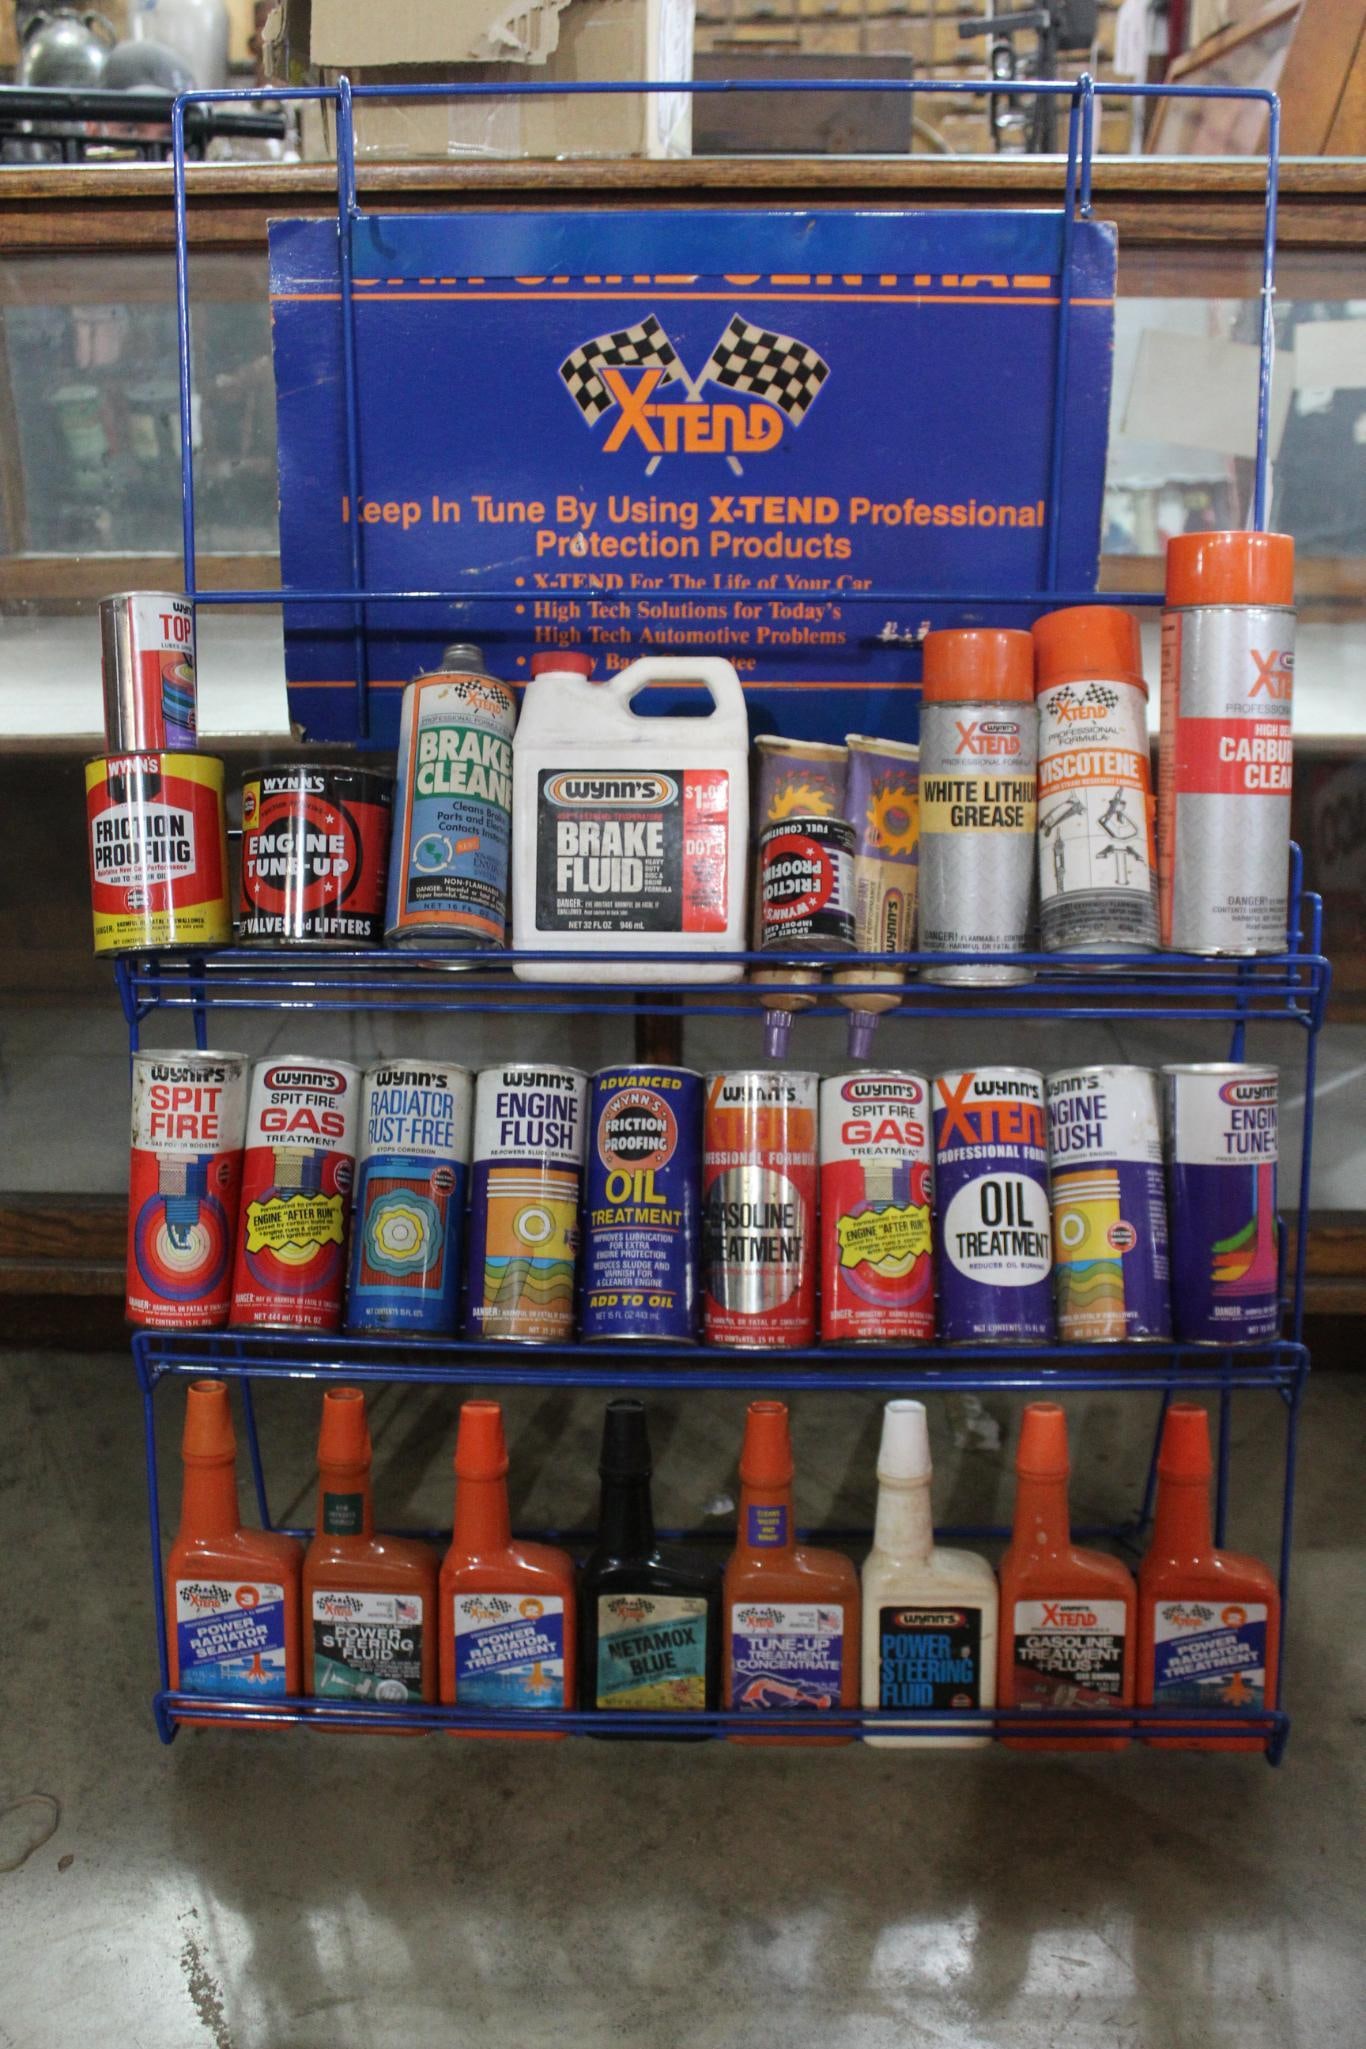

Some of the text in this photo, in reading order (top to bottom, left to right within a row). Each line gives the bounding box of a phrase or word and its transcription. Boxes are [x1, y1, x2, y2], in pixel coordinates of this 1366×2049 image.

[432, 496, 460, 522] In
[472, 496, 545, 523] Tune
[557, 496, 597, 529] By
[609, 496, 699, 530] Using
[709, 496, 839, 524] X-TEND
[850, 497, 1045, 528] Professional
[537, 530, 852, 558] Protection Products
[631, 574, 663, 589] For
[670, 574, 706, 589] The
[714, 574, 751, 590] Life
[757, 575, 777, 590] of
[837, 575, 872, 590] Car
[533, 601, 842, 622] High Tech Solutions for Today's
[159, 614, 191, 643] TOP
[535, 626, 846, 646] High Tech Automotive Problems
[1255, 724, 1278, 736] HIGH
[108, 757, 159, 777] WYNN'S
[1040, 751, 1140, 787] VISCOTENE
[264, 775, 325, 794] WYNN'S
[566, 781, 655, 799] wynn's
[924, 781, 1036, 803] WHITE LITHIU
[453, 801, 484, 814] Cleans
[951, 805, 1024, 827] GREASE
[437, 811, 484, 825] Parts and
[96, 815, 185, 844] FRICTION
[439, 822, 480, 835] Contacts
[806, 823, 828, 834] FUEL
[249, 834, 345, 855] ENGINE
[557, 821, 663, 857] BRAKE
[95, 840, 191, 869] PROOFING
[247, 857, 350, 878] TUNE-UP
[557, 856, 643, 893] FLUID
[315, 917, 371, 935] LIFTERS
[584, 921, 592, 929] 32
[151, 1065, 225, 1083] wynn's
[276, 1072, 335, 1088] wynn's
[377, 1071, 448, 1088] wynn's
[503, 1072, 574, 1091] wynn's
[600, 1075, 683, 1091] ADVANCED
[151, 1085, 222, 1112] SPIT
[854, 1084, 913, 1098] wynn's
[974, 1080, 1039, 1099] wynn's
[271, 1093, 336, 1108] SPIT FIRE
[371, 1090, 454, 1120] RADIATOR
[496, 1092, 578, 1123] ENGINE
[852, 1105, 916, 1118] SPIT FIRE
[1231, 1108, 1278, 1130] ENGIN
[150, 1112, 219, 1139] FIRE
[260, 1108, 344, 1138] GAS
[368, 1117, 454, 1148] RUST-FREE
[605, 1117, 667, 1133] FRICTION
[267, 1134, 336, 1147] TREATMENT
[500, 1120, 573, 1150] FLUSH
[841, 1120, 924, 1147] GAS
[604, 1136, 667, 1153] PROOFING
[937, 1145, 1020, 1165] PROFESSIONAL
[605, 1167, 666, 1204] OIL
[981, 1181, 1034, 1228] OIL
[254, 1211, 282, 1226] ENGINE
[591, 1207, 682, 1226] TREATMENT
[625, 1232, 673, 1243] LUBRICATION
[846, 1226, 876, 1241] ENGINE
[620, 1251, 666, 1259] PROTECTION
[956, 1231, 1049, 1260] TREATMENT
[622, 1261, 652, 1270] SLUDGE
[654, 1262, 670, 1271] AND
[590, 1294, 673, 1308] ADD TO OIL
[196, 1617, 254, 1638] POWER
[904, 1614, 956, 1624] wynn's
[190, 1625, 268, 1650] RADIATOR
[334, 1626, 401, 1640] POWER
[477, 1626, 536, 1648] POWER
[608, 1627, 697, 1659] NETAMOX
[1026, 1636, 1114, 1649] GASOLINE
[195, 1636, 267, 1659] SEALANT
[322, 1635, 414, 1652] STEERING
[469, 1634, 549, 1660] RADIATOR
[748, 1638, 830, 1651] TUNE-UP
[882, 1633, 952, 1660] POWER
[1177, 1635, 1238, 1656] POWER
[343, 1648, 394, 1661] FLUID
[464, 1641, 557, 1670] TREATMENT
[630, 1650, 677, 1677] BLUE
[749, 1651, 829, 1661] TREATMENT
[1018, 1648, 1121, 1661] TREATMENT
[1164, 1650, 1259, 1678] TREATMENT
[1168, 1643, 1251, 1668] RADIATOR
[736, 1660, 839, 1671] CONCENTRATE
[882, 1659, 974, 1685] STEERING
[882, 1683, 934, 1706] FLUID
